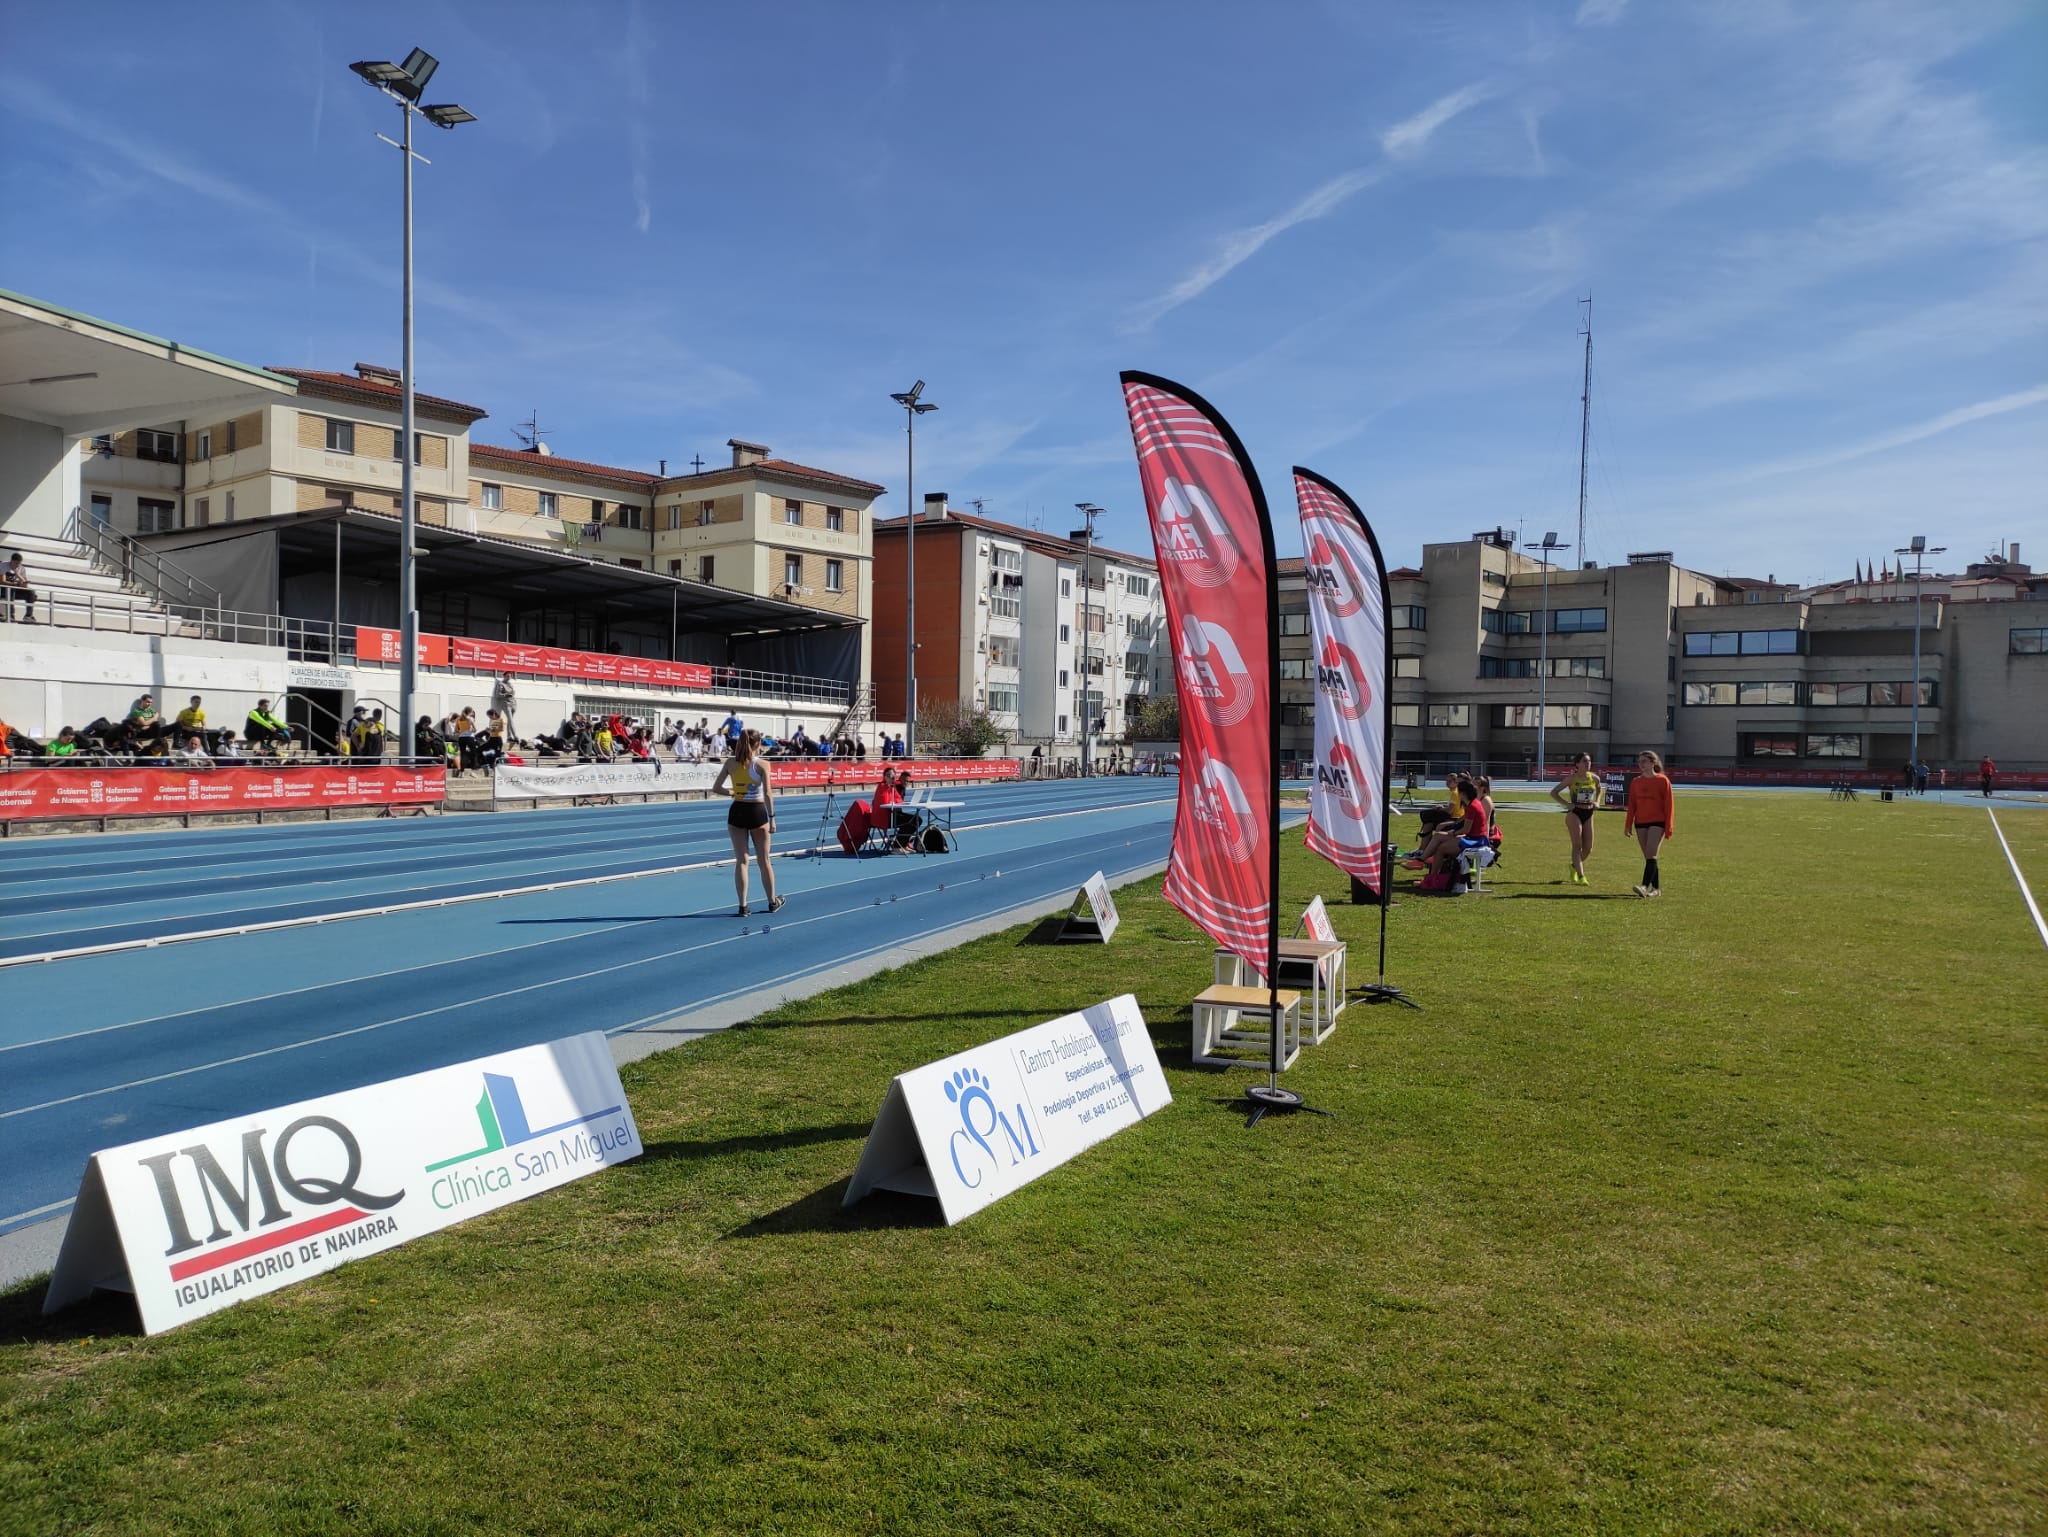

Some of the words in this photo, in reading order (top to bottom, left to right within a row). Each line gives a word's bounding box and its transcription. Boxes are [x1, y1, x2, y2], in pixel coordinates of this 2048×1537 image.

[0, 789, 37, 797] afarroako
[57, 787, 88, 795] Gobierno
[62, 796, 89, 804] Navarra
[159, 785, 186, 793] Gobierno
[163, 793, 186, 801] Navarra
[0, 797, 33, 806] obernua
[1020, 1049, 1055, 1075] Centro
[1065, 1059, 1104, 1082] Especialistas
[1104, 1056, 1112, 1067] en
[1075, 1081, 1106, 1102] Deportiva
[1105, 1080, 1111, 1092] y
[1078, 1111, 1094, 1125] Telf.
[1092, 1104, 1106, 1118] 848
[1105, 1097, 1118, 1111] 412
[1117, 1092, 1130, 1106] 115
[431, 1166, 512, 1210] Clínica
[514, 1150, 559, 1182] San
[560, 1117, 633, 1164] Miguel
[138, 1115, 406, 1257] IMQ
[175, 1251, 295, 1307] IGUALATORIO
[300, 1241, 322, 1264] DE
[325, 1215, 398, 1254] NAVARRA
